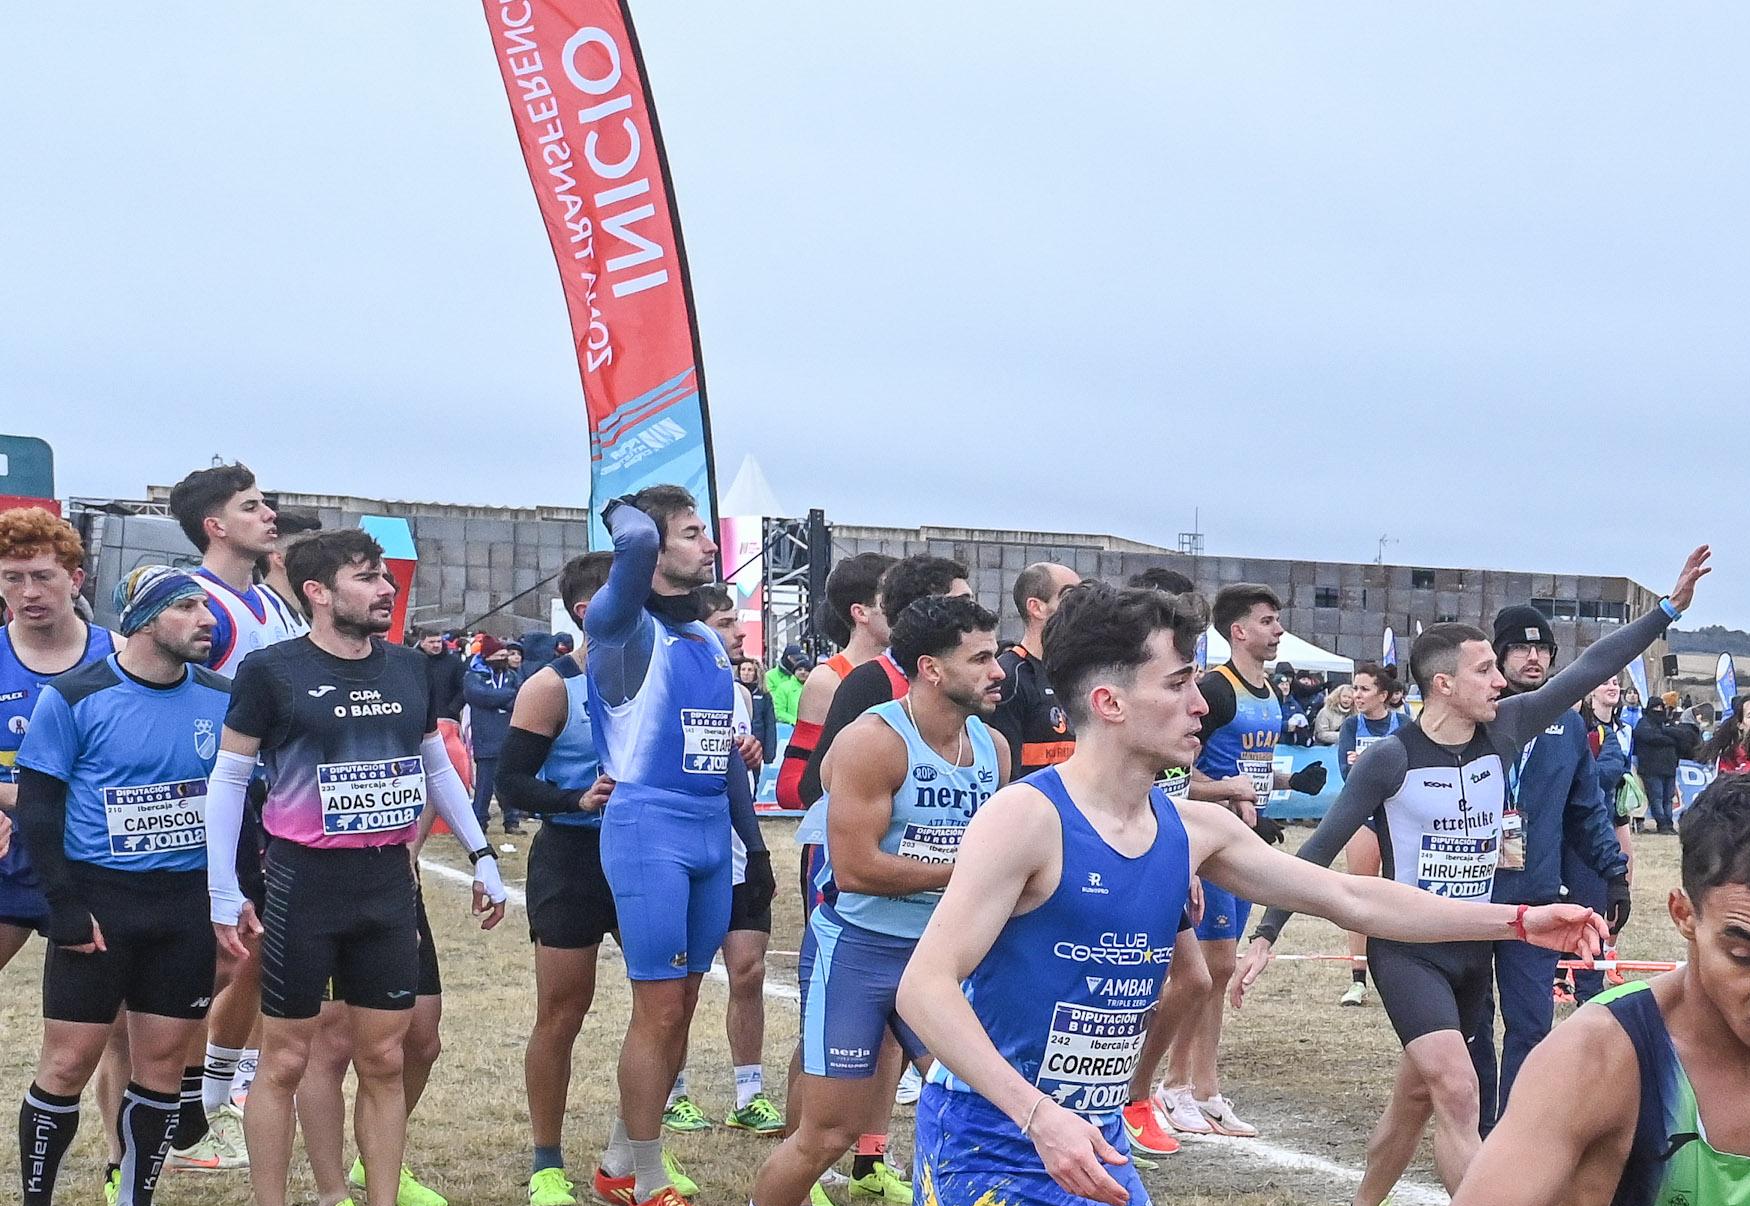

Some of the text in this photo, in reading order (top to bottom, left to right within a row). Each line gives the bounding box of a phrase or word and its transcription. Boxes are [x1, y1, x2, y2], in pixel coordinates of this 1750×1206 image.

[349, 690, 382, 701] CUPA
[334, 705, 347, 717] O
[350, 702, 403, 717] BARCO
[329, 763, 386, 775] DIPUTACIÓN
[330, 771, 386, 782] BURGOS
[116, 785, 171, 797] DIPUTACIÓN
[351, 781, 387, 790] Ibercaja
[116, 793, 172, 804] BURGOS
[327, 788, 422, 811] ADAS CUPA
[137, 803, 173, 813] Ibercaja
[124, 811, 204, 832] CAPISCOL
[1431, 836, 1477, 845] DIPUTACIÓN
[1100, 932, 1148, 948] CLUB
[1100, 978, 1153, 997] AMBAR
[1107, 999, 1147, 1007] TRIPLE ZERO
[1071, 1009, 1138, 1025] DIPUTACIÓN
[1068, 1021, 1136, 1036] BURGOS
[1050, 1035, 1130, 1052] 242 Ibercaja
[1075, 1084, 1132, 1110] Jom
